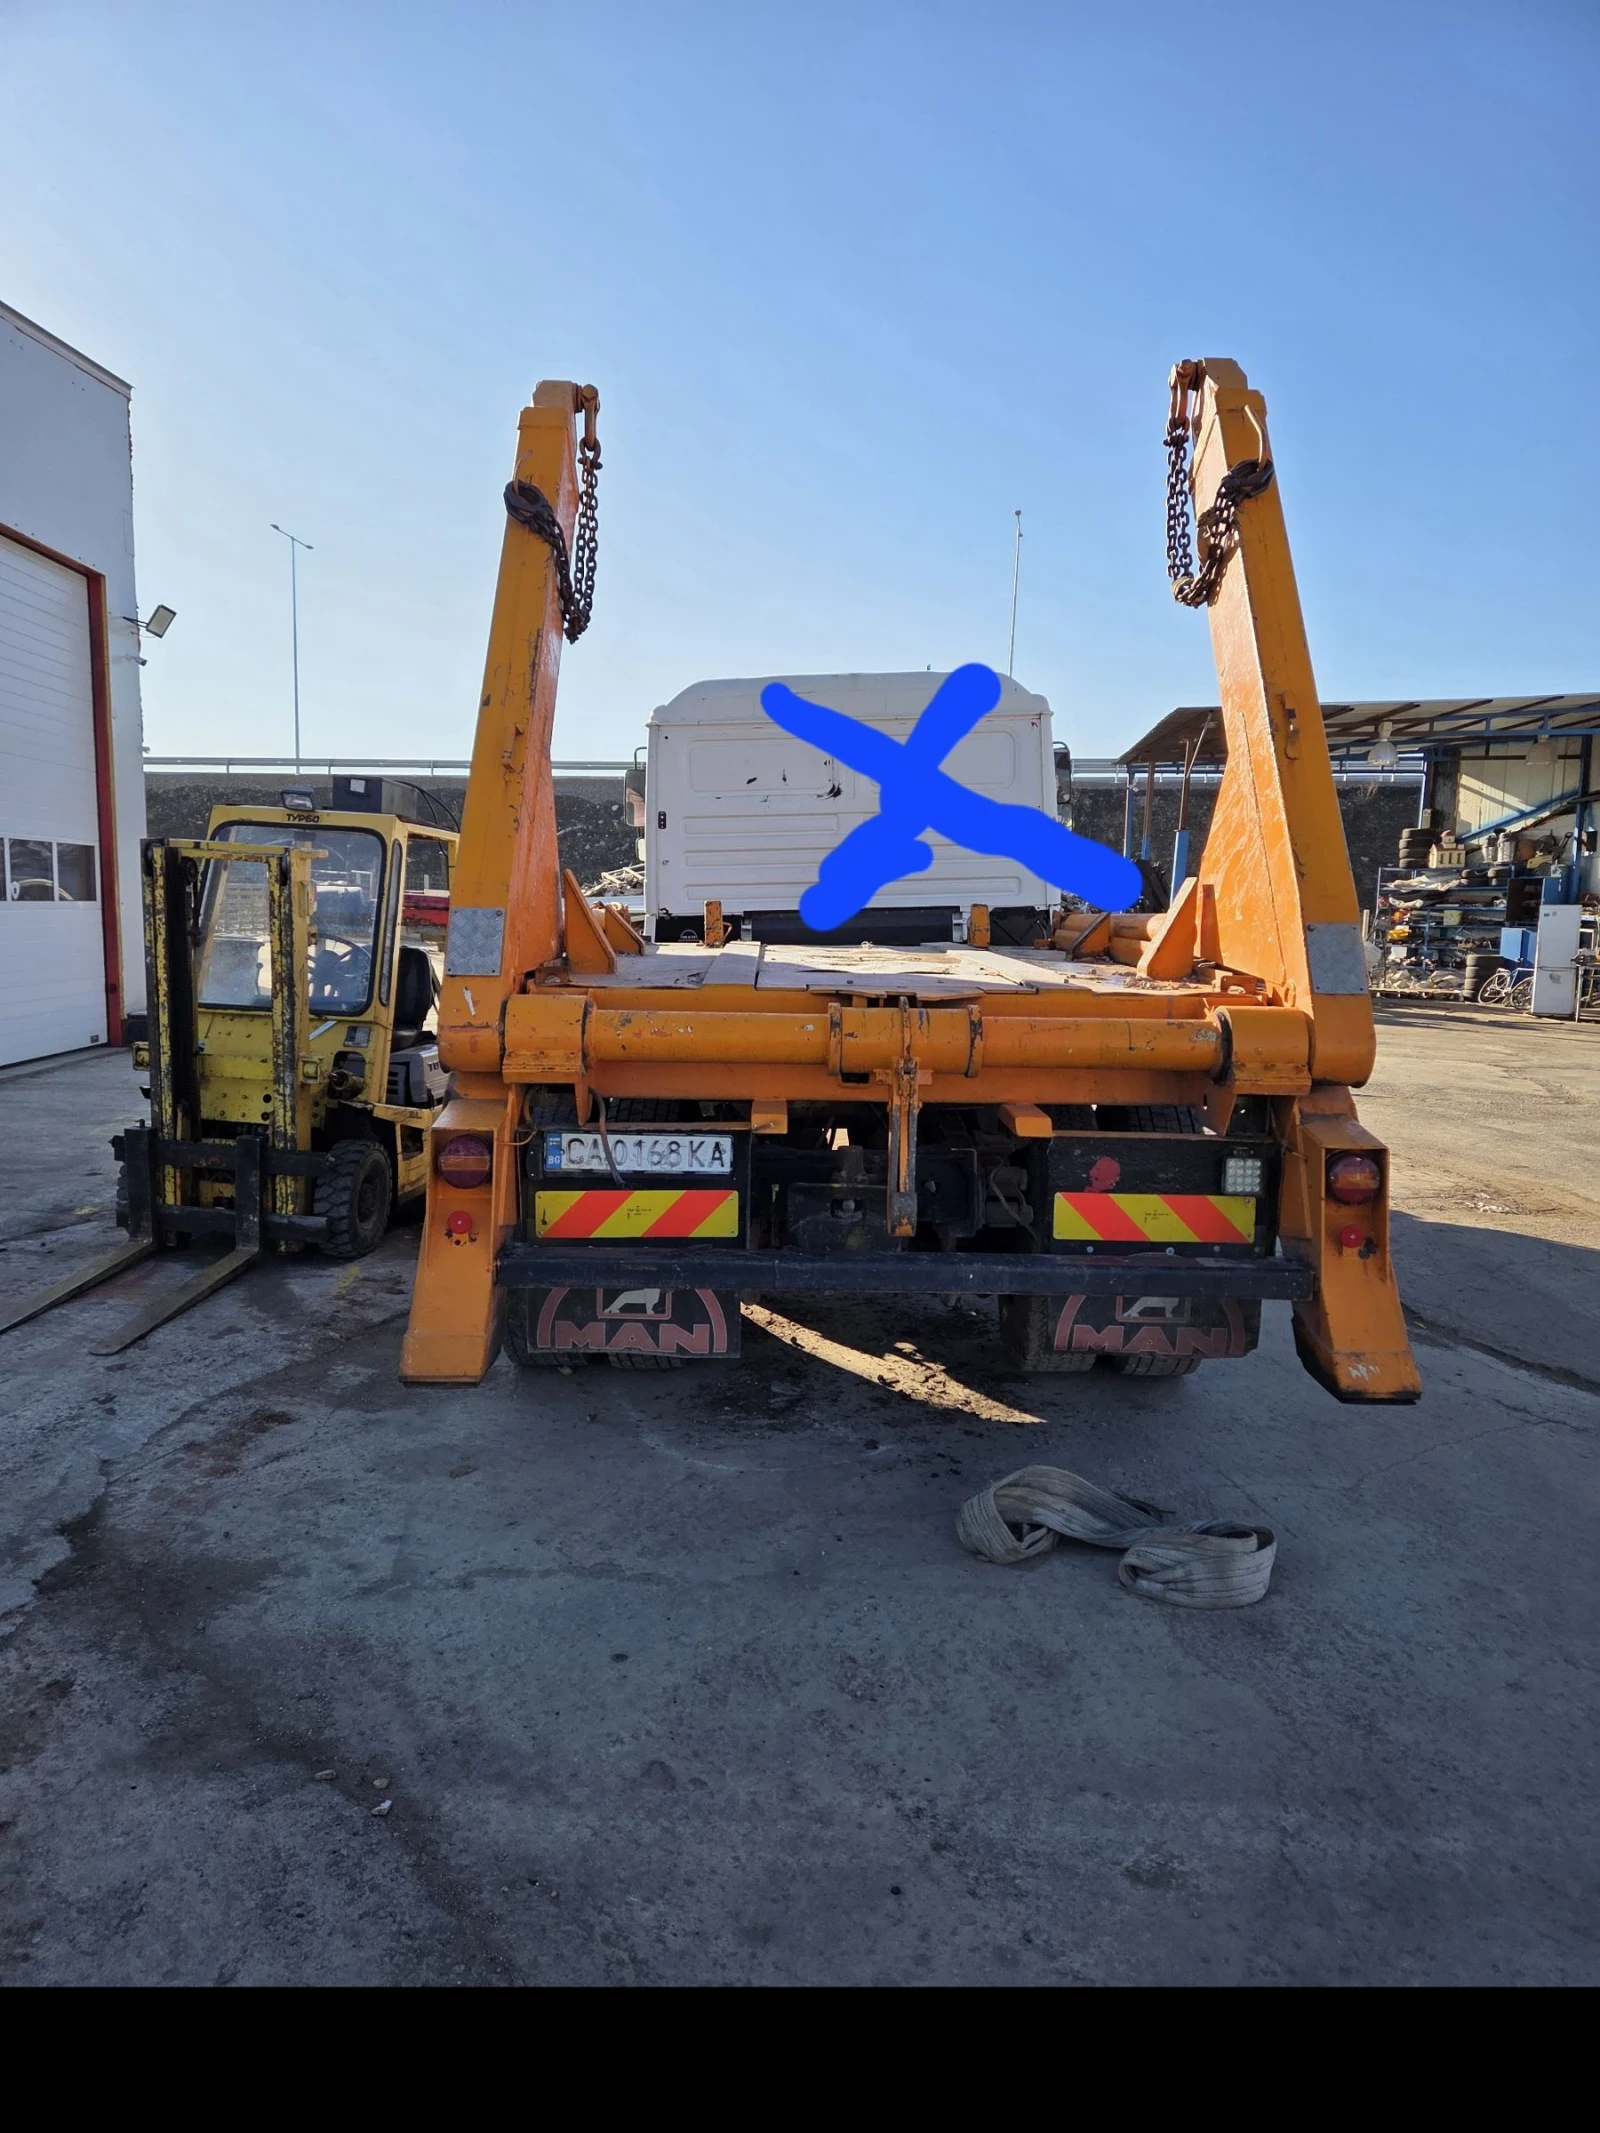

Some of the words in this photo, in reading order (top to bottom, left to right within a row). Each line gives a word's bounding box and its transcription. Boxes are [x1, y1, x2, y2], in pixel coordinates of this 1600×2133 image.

[548, 1155, 561, 1164] BG
[555, 1320, 710, 1354] MAN
[1072, 1324, 1228, 1358] MAN
